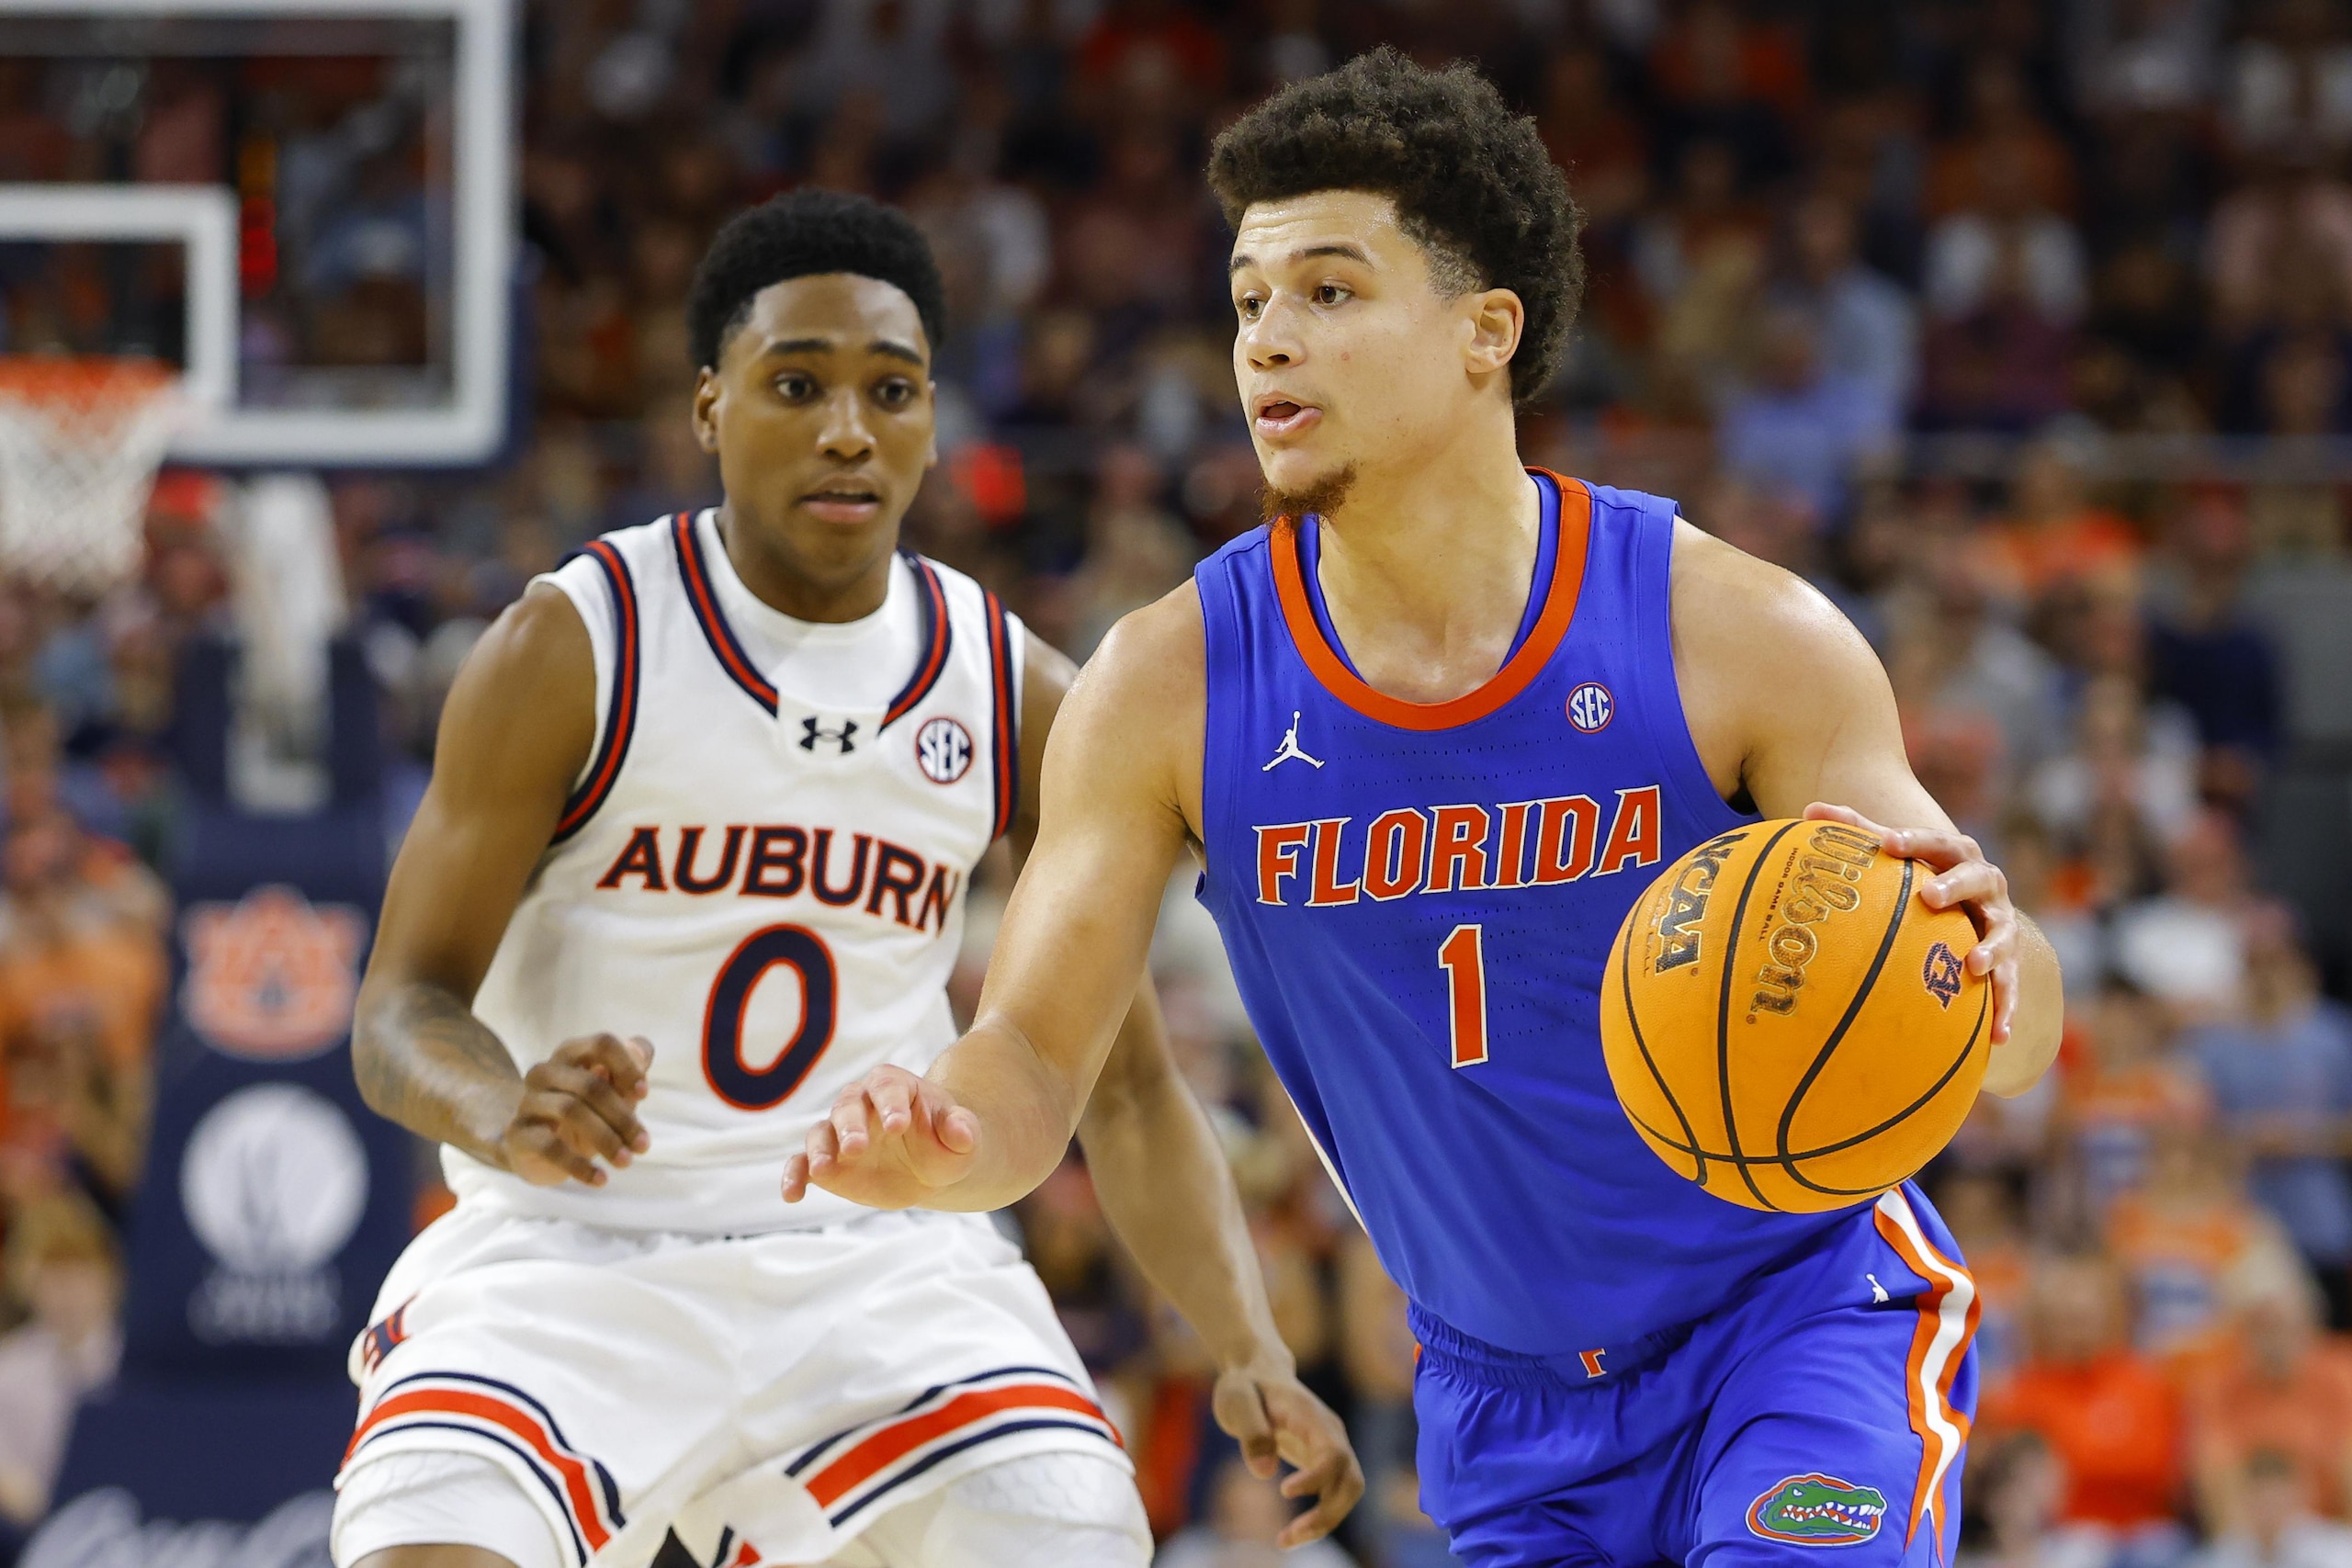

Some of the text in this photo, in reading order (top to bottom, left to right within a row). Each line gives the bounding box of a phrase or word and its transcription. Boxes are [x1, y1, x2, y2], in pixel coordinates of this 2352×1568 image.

[919, 720, 970, 781] SEC
[1570, 687, 1610, 728] SEC
[595, 824, 959, 937] AUBURN
[1251, 784, 1661, 908] FLORIDA
[1655, 832, 1749, 976] NCAA
[1758, 848, 1799, 942] INDOOR GAME BALL
[1750, 826, 1882, 1016] Wilson
[701, 923, 839, 1111] 0
[1438, 924, 1488, 1069] 1
